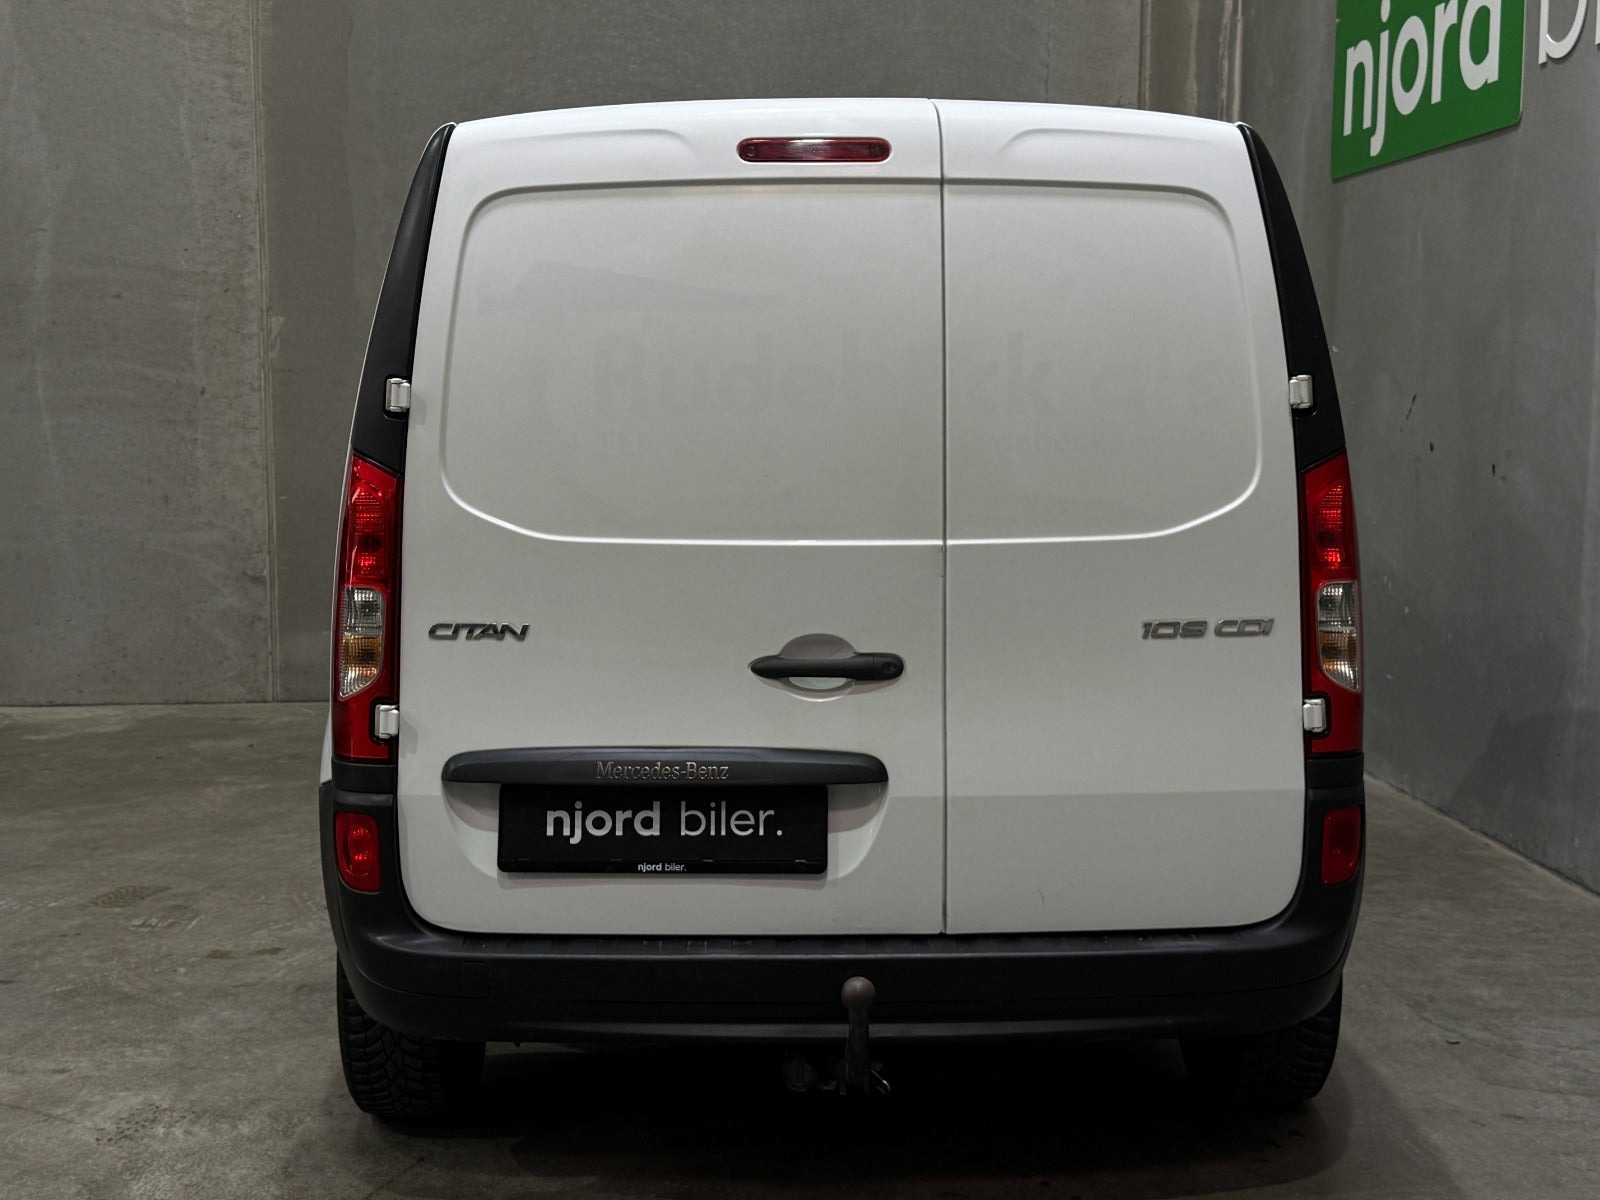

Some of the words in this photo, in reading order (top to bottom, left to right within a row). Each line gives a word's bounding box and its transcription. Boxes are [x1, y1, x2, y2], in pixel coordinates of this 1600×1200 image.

[1343, 0, 1502, 157] njord
[428, 622, 530, 642] CITAN
[1213, 617, 1275, 638] CDI
[594, 760, 730, 781] Mercedes-Benz
[546, 801, 661, 845] njord
[680, 801, 783, 837] biler.
[637, 862, 662, 873] njord
